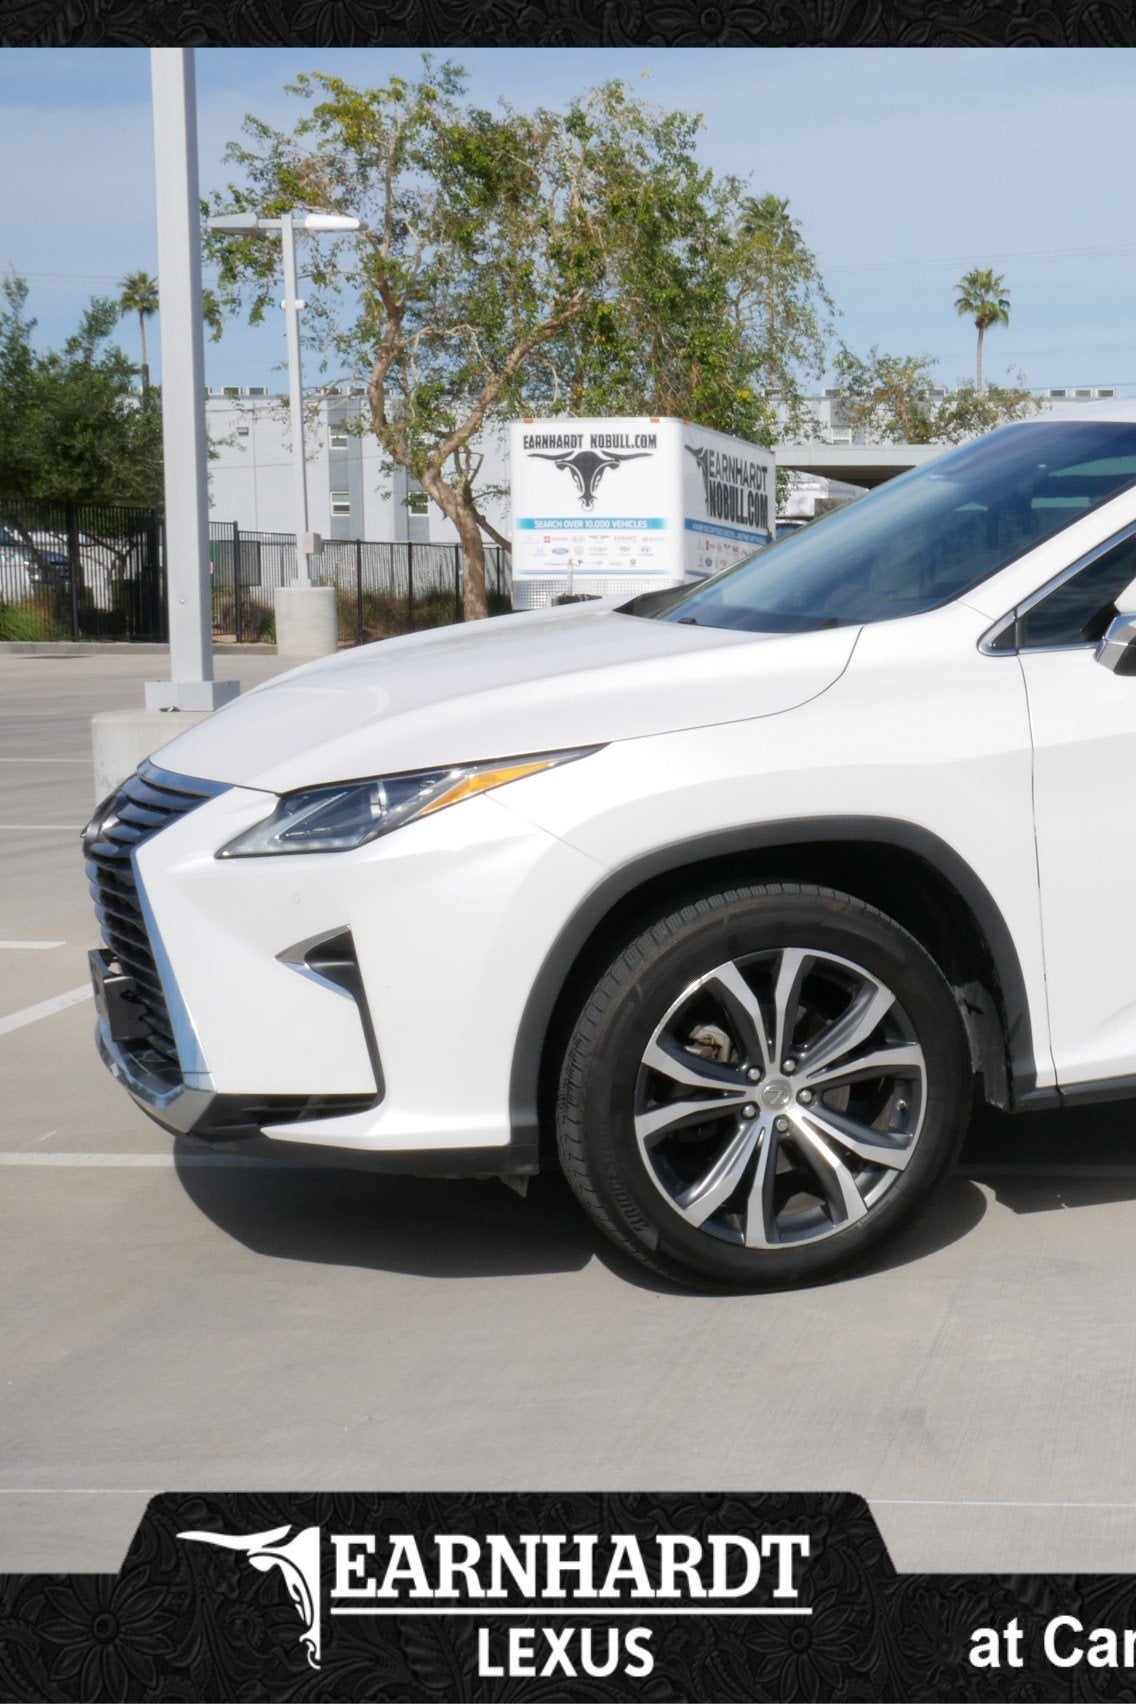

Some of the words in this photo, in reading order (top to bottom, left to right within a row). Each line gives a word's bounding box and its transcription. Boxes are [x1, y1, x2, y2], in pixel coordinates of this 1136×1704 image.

[523, 434, 583, 449] EARNHARDT
[590, 434, 657, 448] NOBULL.COM
[709, 449, 768, 492] EARNHARDT
[709, 479, 769, 530] NOBULL.COM
[534, 520, 562, 529] SEARCH
[564, 520, 584, 529] OVER
[586, 520, 610, 529] 10,000
[612, 520, 649, 529] VEHICLES
